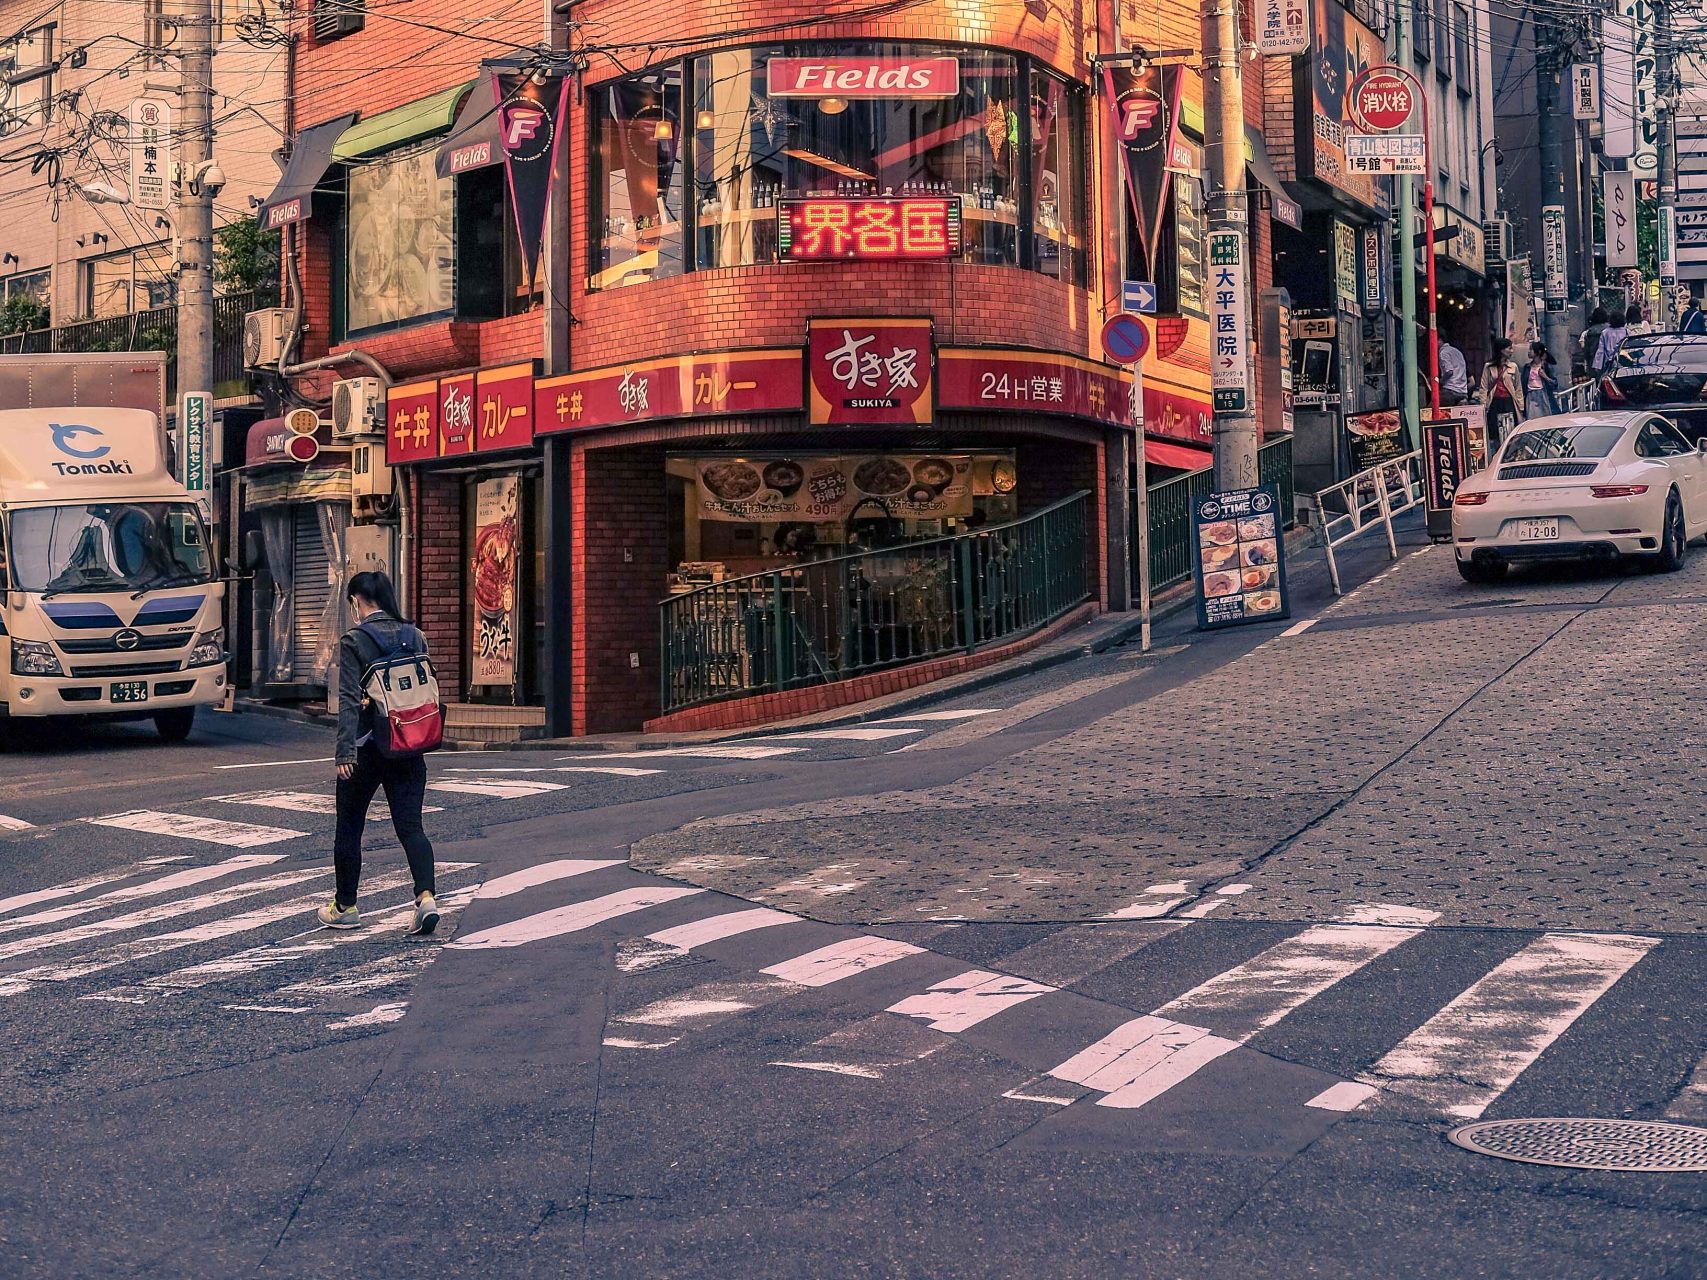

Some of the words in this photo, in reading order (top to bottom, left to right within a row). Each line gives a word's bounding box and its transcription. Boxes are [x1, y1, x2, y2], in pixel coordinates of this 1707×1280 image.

[1262, 37, 1305, 48] 0120-142-760
[795, 64, 932, 90] Fields
[144, 107, 155, 121] 質
[1362, 91, 1409, 113] 消火栓
[453, 145, 489, 169] Fields
[1349, 138, 1401, 155] 青山製図
[144, 145, 157, 175] 楠本
[1349, 157, 1381, 171] 1号館
[270, 202, 300, 227] Fields
[1278, 202, 1295, 222] Fields
[794, 203, 945, 252] 界各国
[1366, 238, 1378, 297] スマホ修理王
[1215, 268, 1238, 356] 大平医院
[1303, 321, 1330, 335] 수리
[824, 329, 919, 397] すき家
[618, 368, 650, 416] すき家
[695, 371, 757, 406] カレー
[981, 372, 1063, 403] 24H営業
[443, 384, 472, 431] すき家
[482, 394, 527, 439] カレー
[556, 389, 583, 423] 牛丼
[851, 399, 893, 408] SUKIYA
[393, 405, 431, 451] 牛丼
[189, 399, 201, 489] レクサス教育センター
[51, 459, 133, 476] Tomaki
[1438, 434, 1455, 501] Fields
[808, 474, 846, 492] どちらも
[815, 484, 847, 503] お得な
[1221, 502, 1251, 514] TIME
[1529, 527, 1556, 538] 12-08
[480, 620, 512, 662] うな牛
